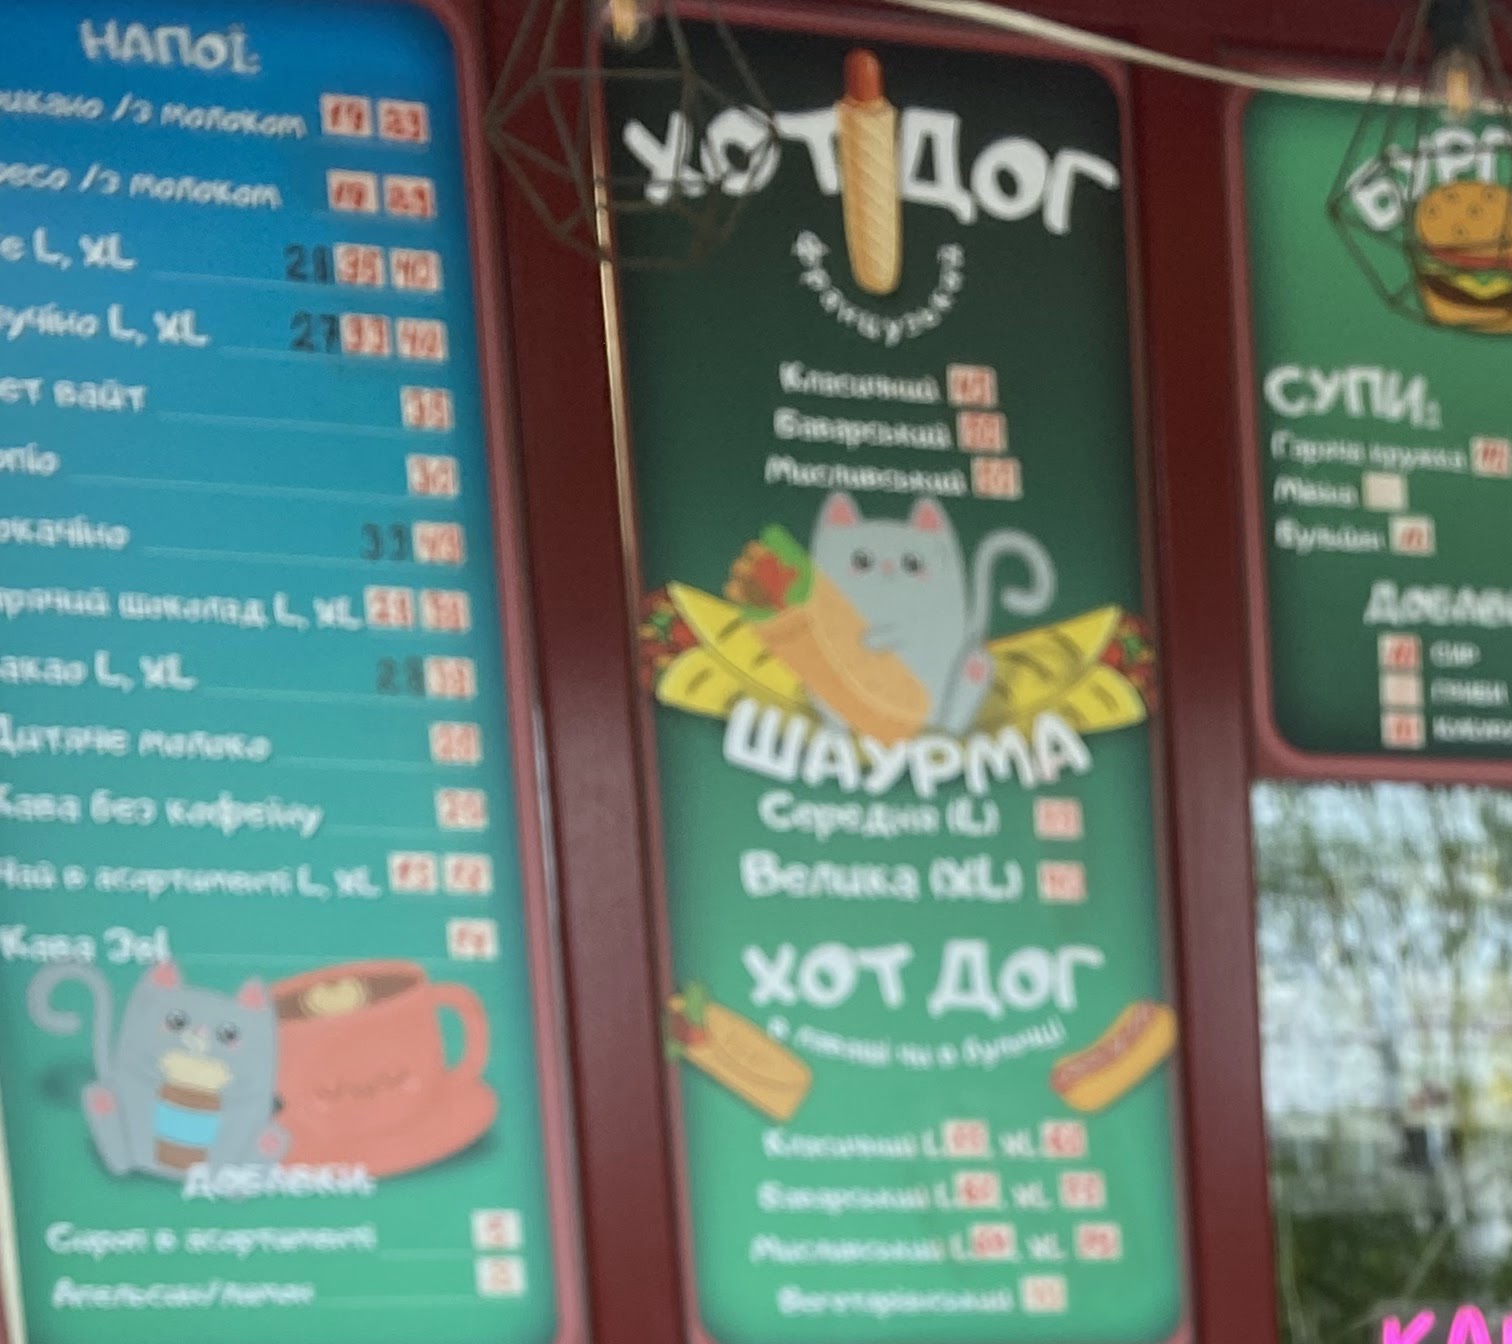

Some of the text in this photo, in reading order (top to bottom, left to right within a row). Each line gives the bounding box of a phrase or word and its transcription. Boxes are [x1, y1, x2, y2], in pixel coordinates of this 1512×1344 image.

[80, 18, 260, 75] НАПОЇ
[160, 101, 308, 139] молоком
[129, 172, 282, 210] молоком
[622, 107, 1120, 235] ХОТ ДОГ
[53, 378, 146, 413] вайт
[0, 586, 111, 622] рячий
[118, 591, 268, 629] шоколад
[138, 729, 272, 762] молоко
[722, 699, 1091, 796] ШАУРМА
[89, 788, 157, 826] без
[740, 848, 921, 901] Велика
[0, 923, 96, 962] Кава
[742, 939, 1105, 1019] ХОТ ДОГ
